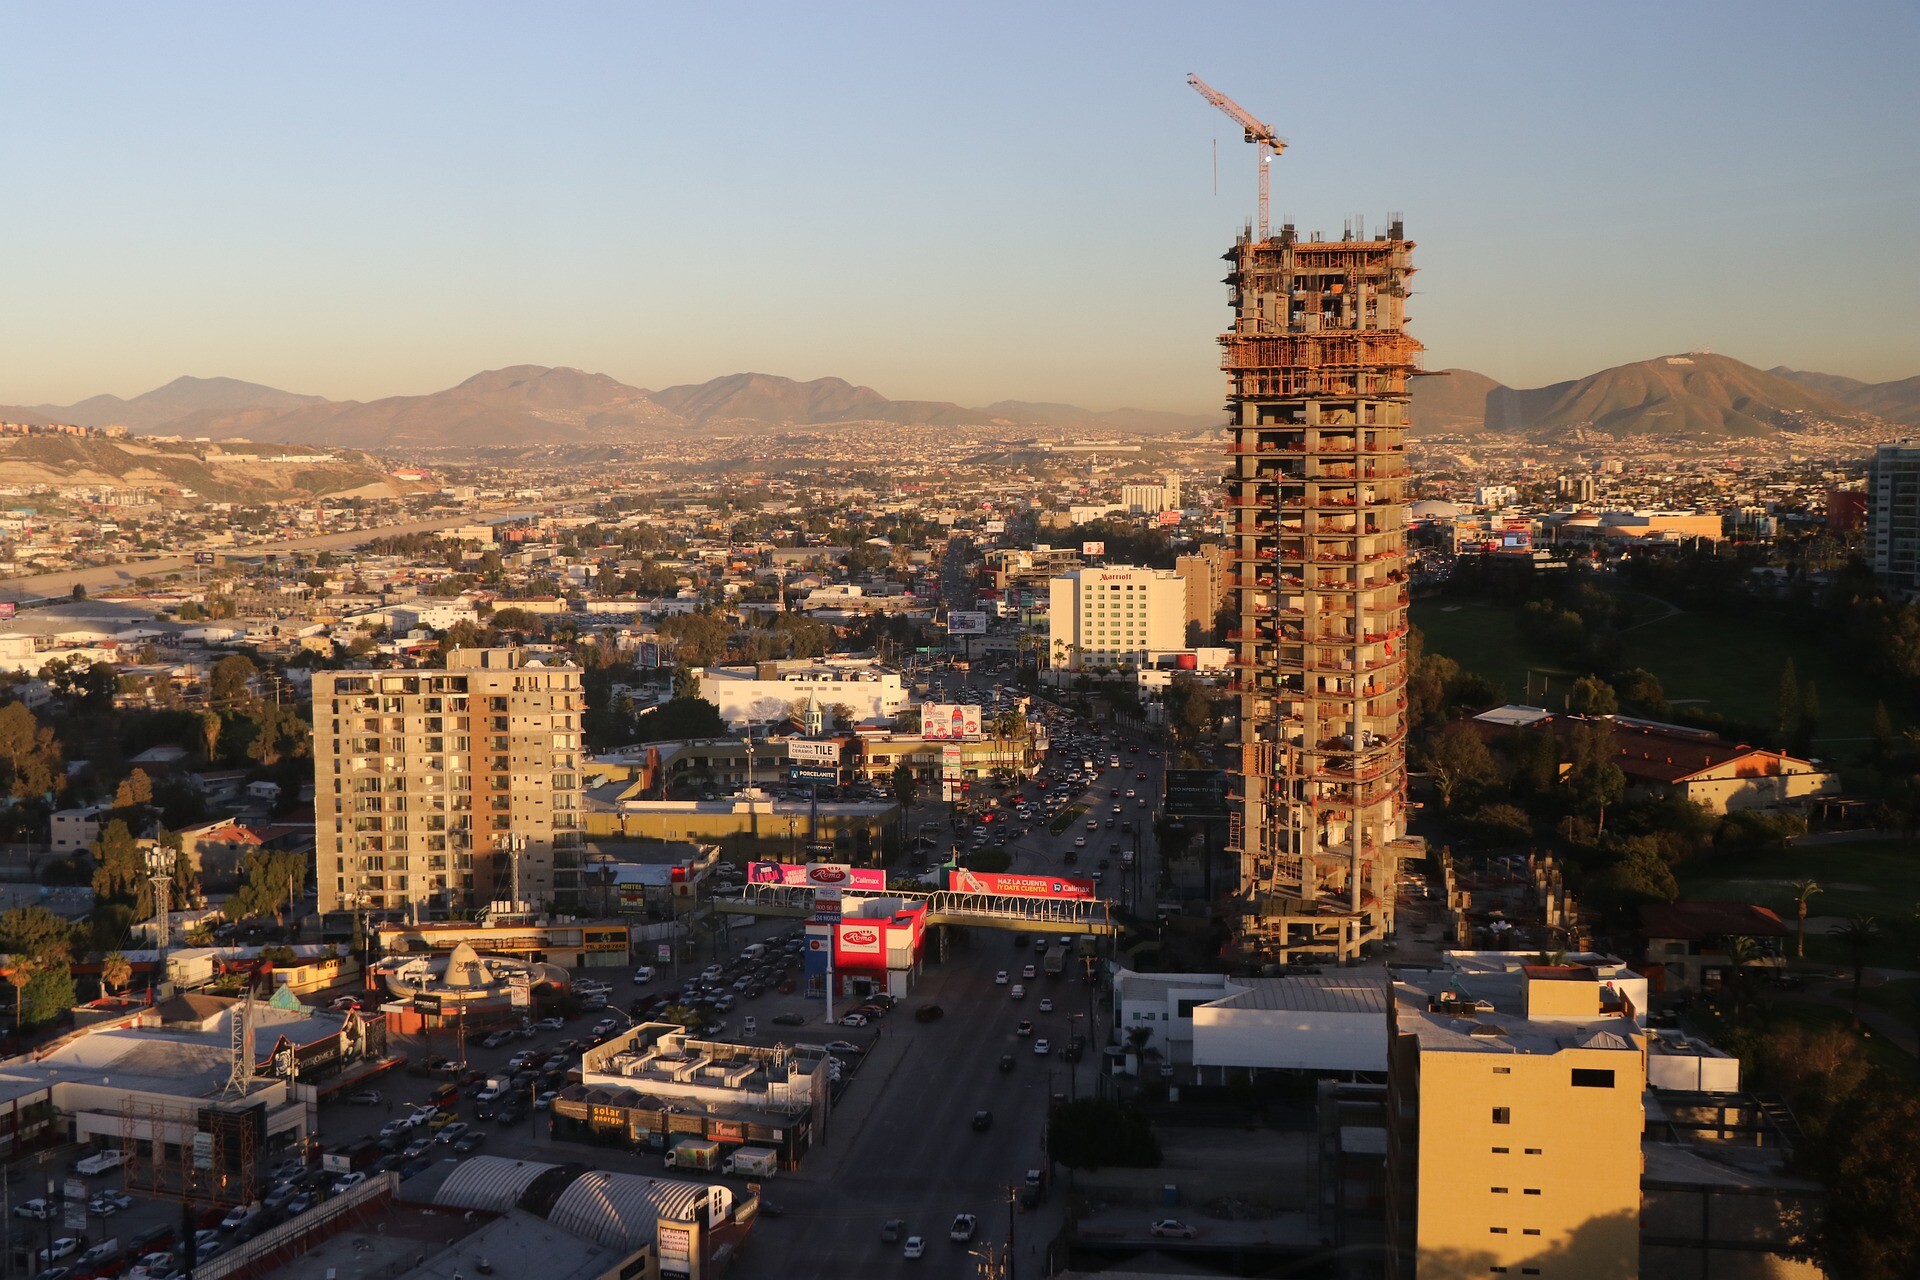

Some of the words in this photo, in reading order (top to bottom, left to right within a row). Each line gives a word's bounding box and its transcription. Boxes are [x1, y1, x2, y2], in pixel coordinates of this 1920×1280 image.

[1099, 573, 1132, 581] Marriott
[814, 745, 833, 755] TILE
[799, 770, 836, 778] PORCELANITE
[813, 869, 841, 880] Roma
[855, 876, 879, 885] Calimax
[1063, 885, 1090, 893] Calimax
[846, 932, 873, 943] Roma
[593, 1106, 620, 1117] solar
